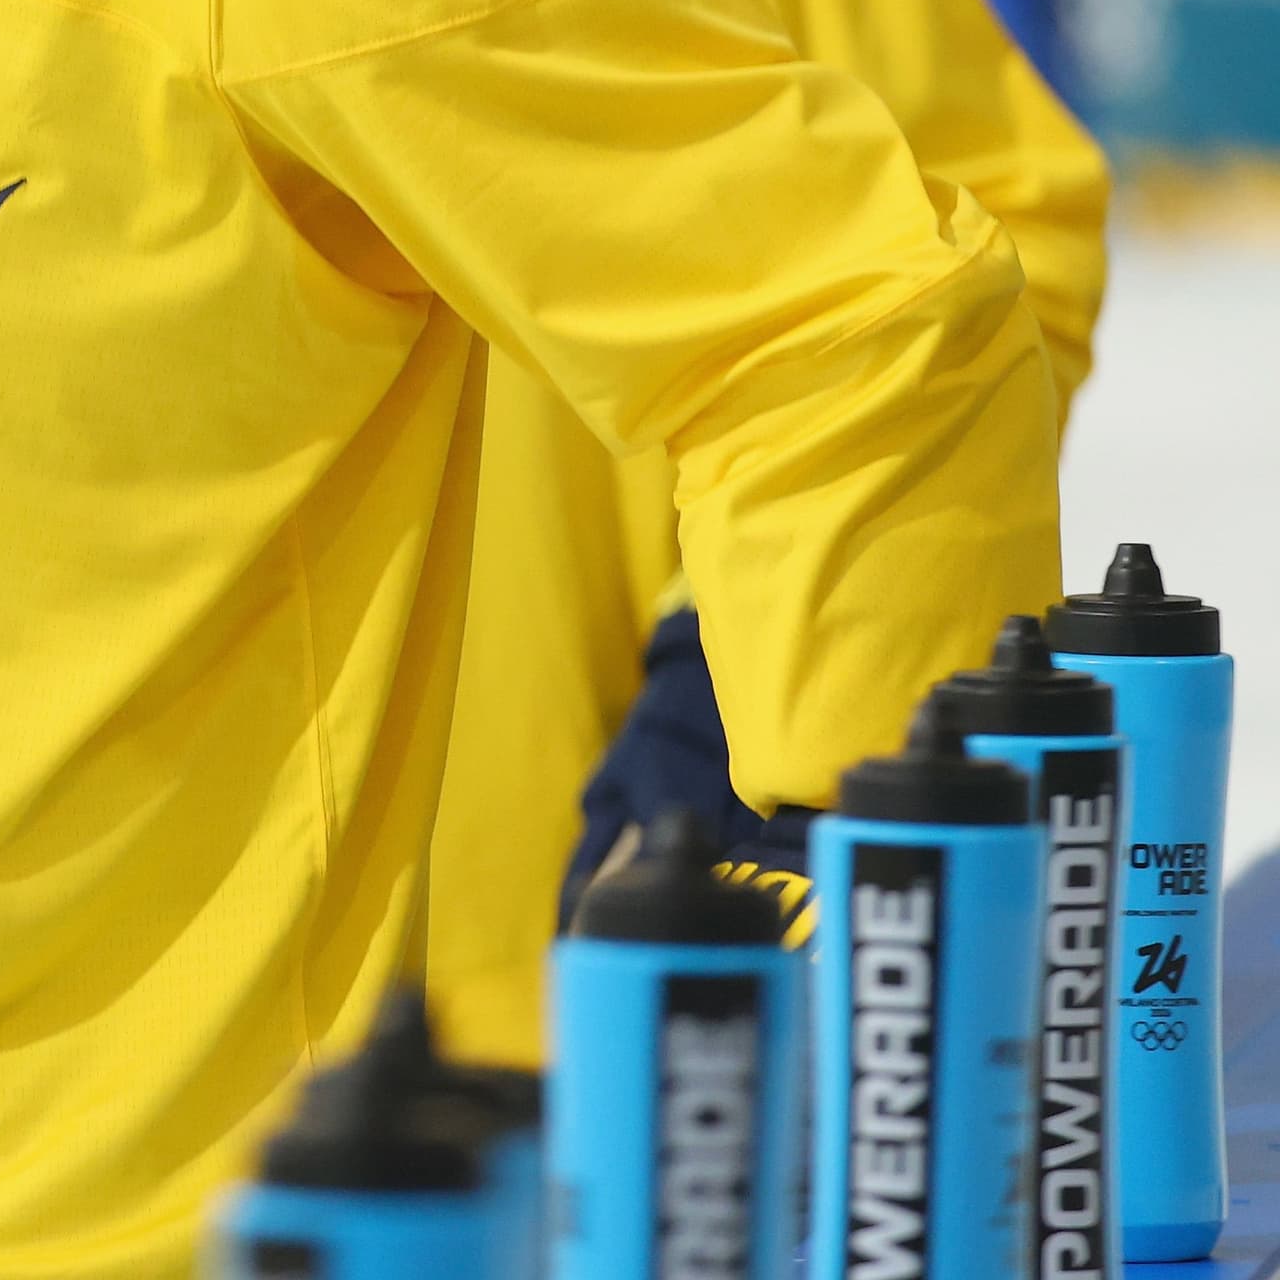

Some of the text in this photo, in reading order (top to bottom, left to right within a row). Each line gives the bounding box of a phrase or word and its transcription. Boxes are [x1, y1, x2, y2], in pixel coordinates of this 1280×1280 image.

[1129, 843, 1207, 869] OWER
[1157, 870, 1208, 896] ADE
[1042, 794, 1113, 1280] POWERADE
